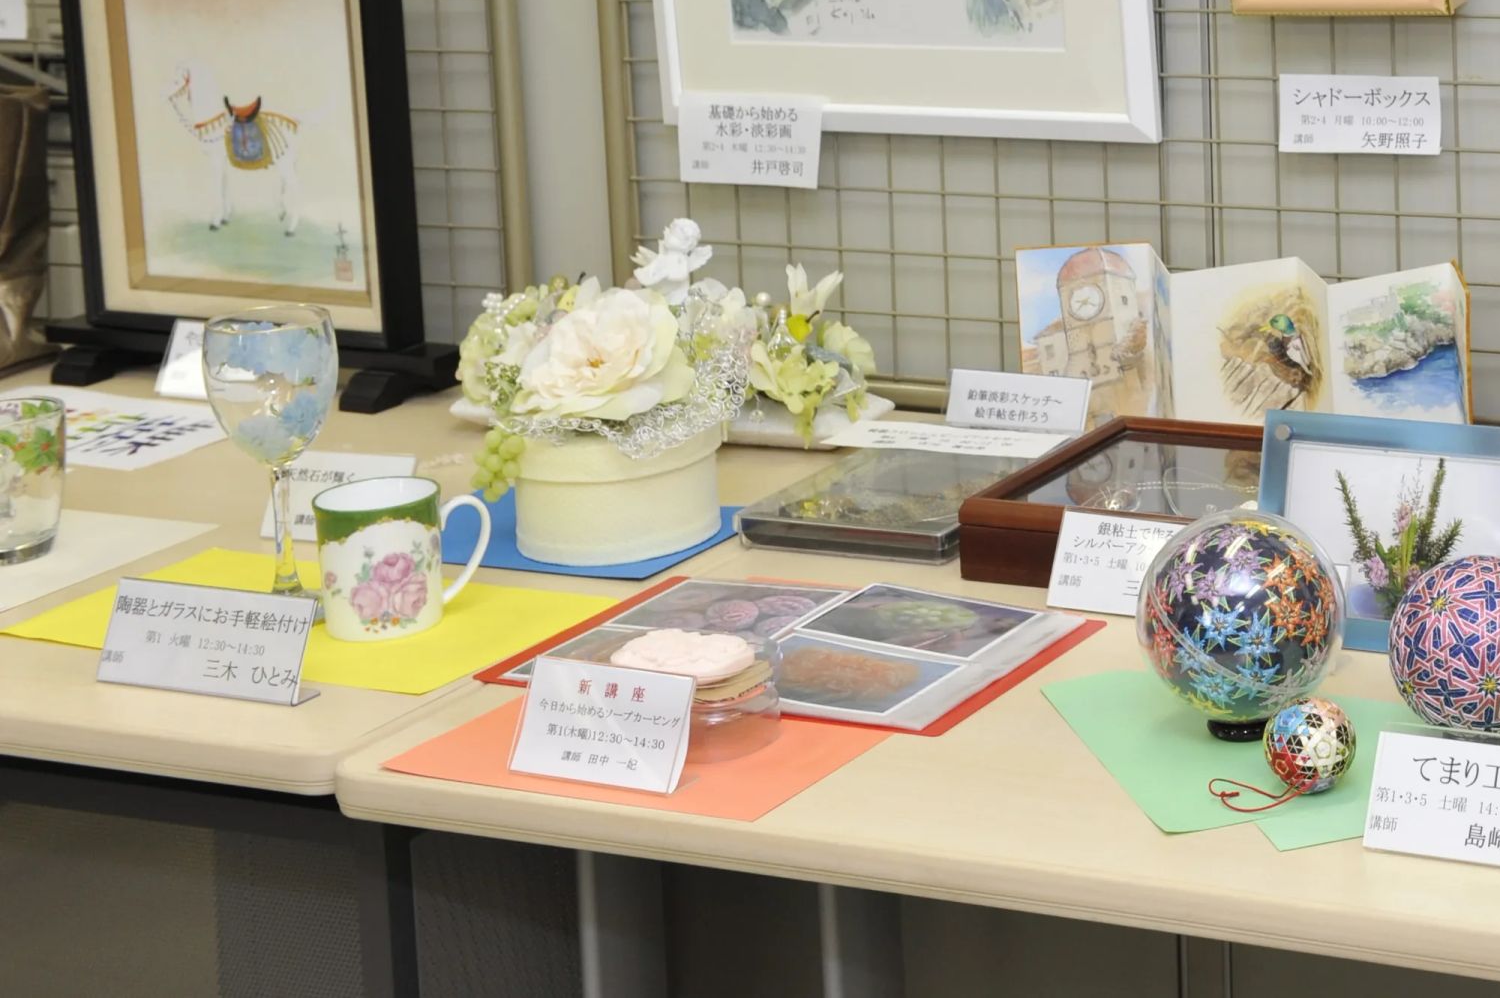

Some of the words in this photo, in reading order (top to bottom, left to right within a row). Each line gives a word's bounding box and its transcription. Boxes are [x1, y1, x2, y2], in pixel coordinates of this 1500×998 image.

[1293, 87, 1432, 108] シャドーボックス
[709, 104, 798, 122] 基礎から始める
[716, 121, 792, 138] 水彩・淡彩画
[1361, 131, 1428, 149] 矢野照子
[752, 159, 804, 177] 井戸啓司
[116, 595, 309, 636] 陶器とガラスにお手軽絵付け
[203, 659, 238, 681] 三木
[251, 665, 298, 688] ひとみ
[539, 698, 680, 729] 今日から始めるソープカービング
[561, 750, 581, 762] 講師
[587, 753, 609, 766] 田中
[1437, 795, 1468, 813] 土曜
[1369, 815, 1398, 832] 講師
